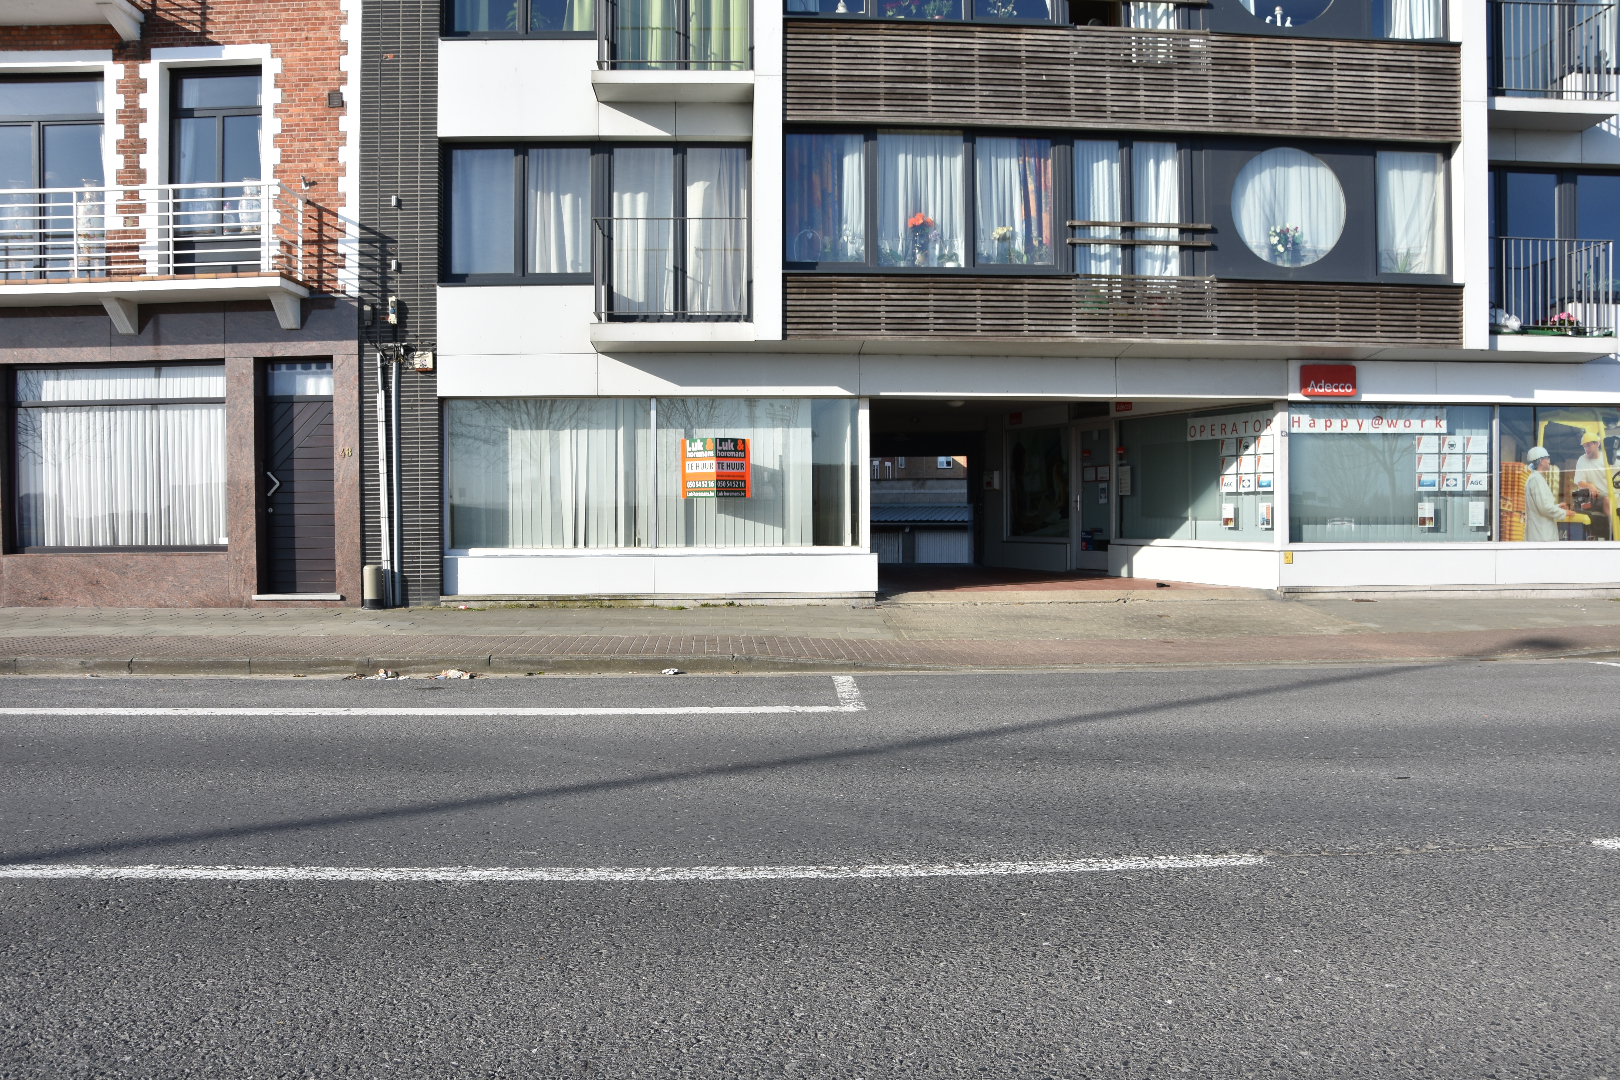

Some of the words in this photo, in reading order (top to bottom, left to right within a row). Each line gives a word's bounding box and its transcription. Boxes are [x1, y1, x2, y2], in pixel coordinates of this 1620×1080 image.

[1307, 380, 1353, 393] Adecco
[1188, 418, 1273, 438] OPERATOR
[686, 439, 703, 451] Luk
[716, 439, 734, 450] Luk
[340, 447, 352, 458] 48
[687, 462, 694, 471] TE
[695, 462, 714, 471] HUUR
[717, 462, 725, 470] TE
[726, 462, 745, 471] HUUR
